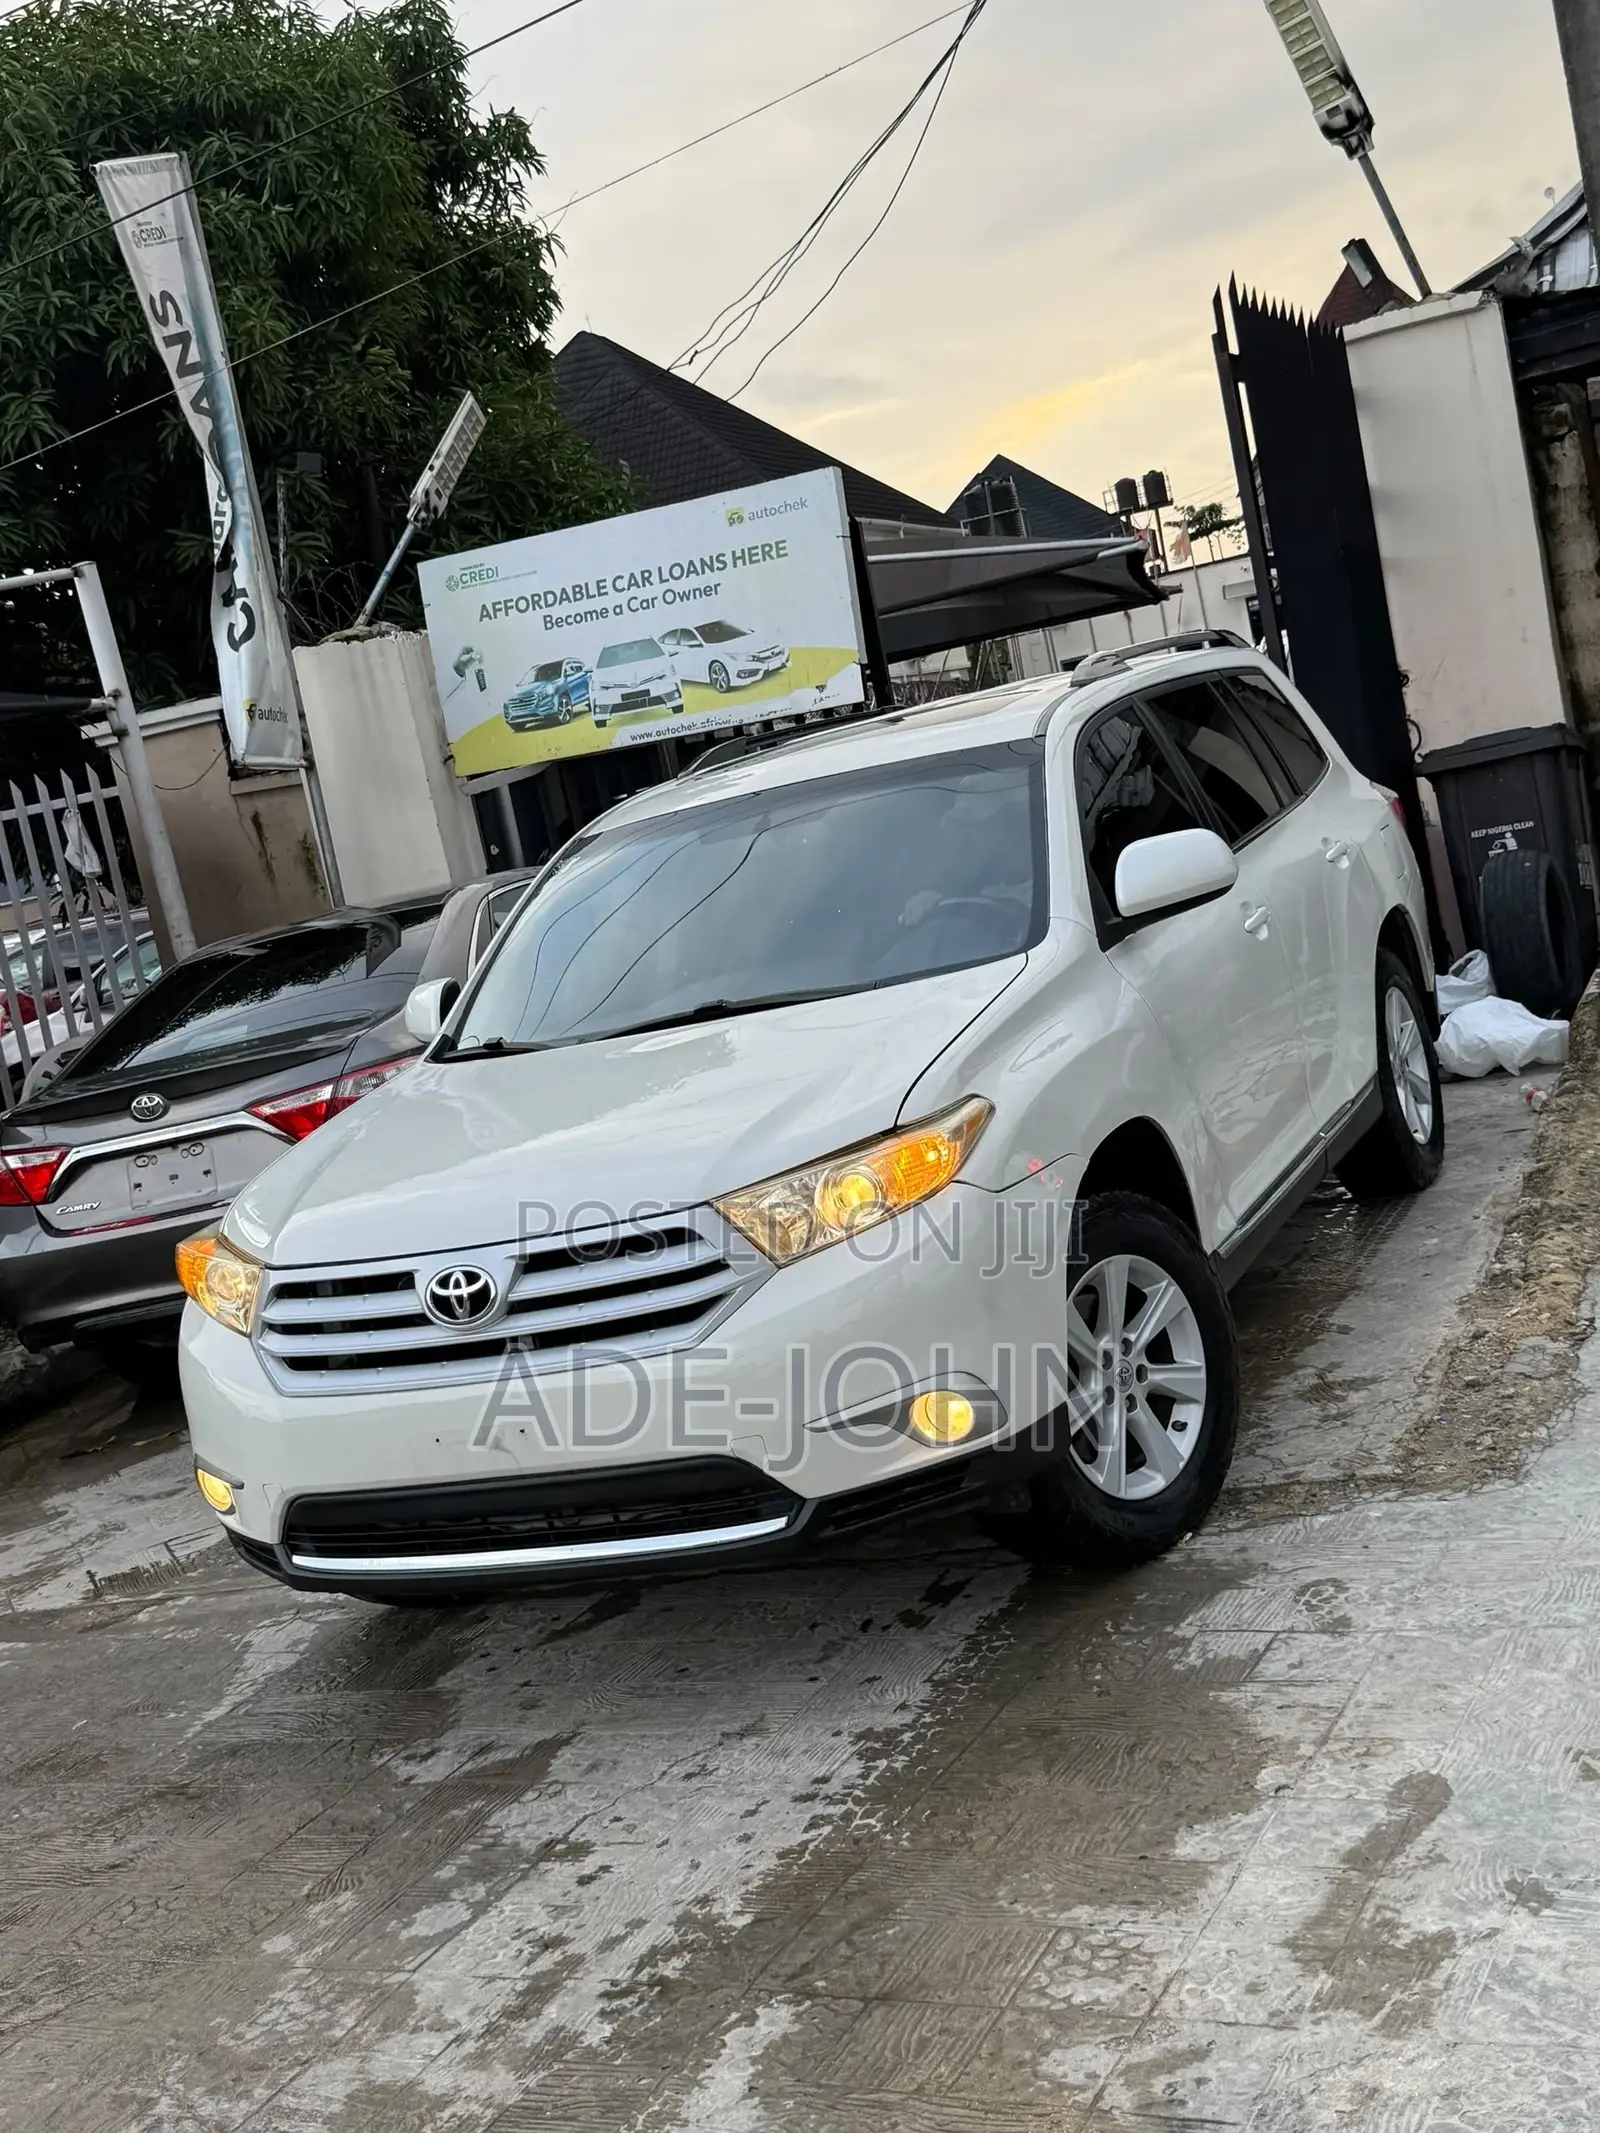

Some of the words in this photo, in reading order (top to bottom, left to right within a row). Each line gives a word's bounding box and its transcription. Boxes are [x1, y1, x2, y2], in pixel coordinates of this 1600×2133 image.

[747, 497, 808, 521] autochek
[459, 566, 499, 585] CREDI
[479, 578, 608, 622] AFFORDABLE
[612, 568, 654, 594] CAR
[657, 552, 728, 584] LOANS
[731, 539, 788, 568] HERE
[543, 606, 610, 631] Become
[613, 603, 624, 616] a
[627, 594, 658, 613] Car
[662, 582, 721, 606] Owner
[1471, 829, 1486, 838] KEEP
[1487, 824, 1513, 835] NIGERIA
[1513, 821, 1534, 830] CLEAN
[56, 1201, 101, 1215] CAMRY
